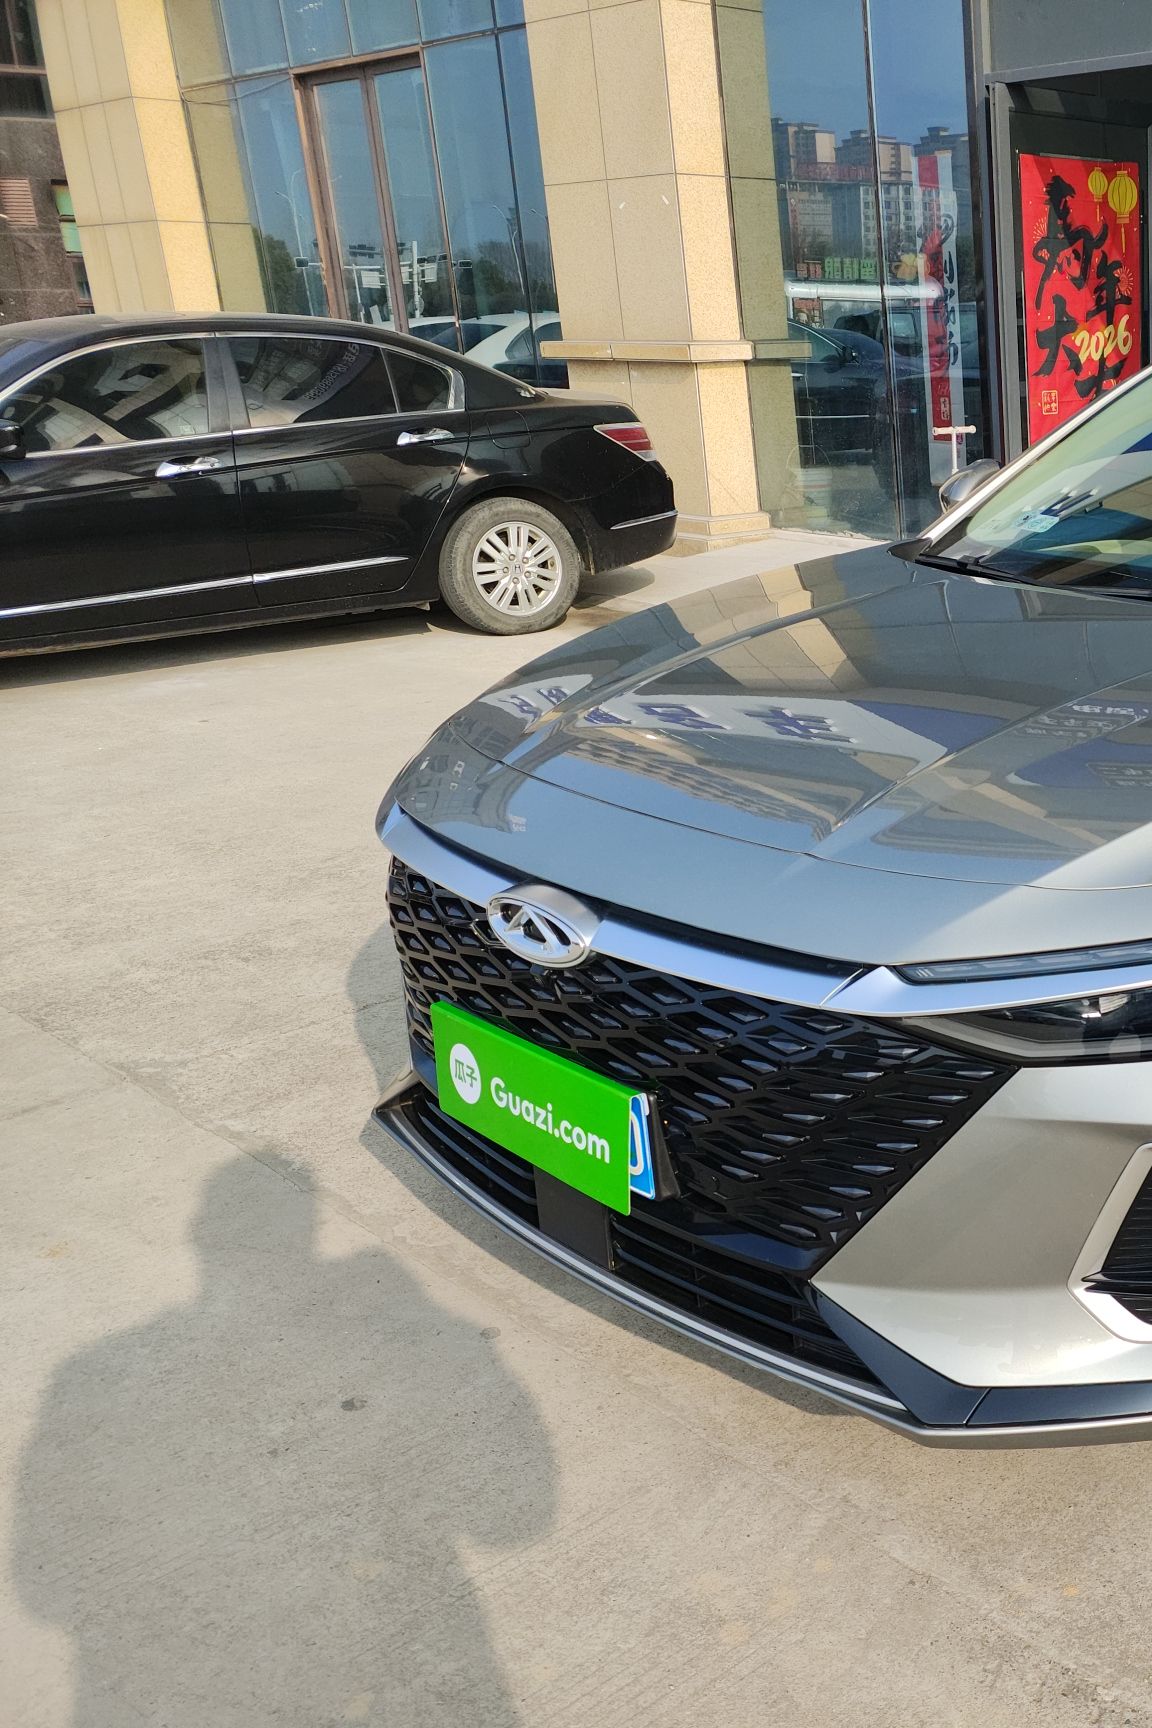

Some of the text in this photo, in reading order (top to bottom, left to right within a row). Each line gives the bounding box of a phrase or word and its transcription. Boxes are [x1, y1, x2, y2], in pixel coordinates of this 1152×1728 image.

[1074, 314, 1132, 365] 2026
[454, 1058, 478, 1088] 瓜子
[490, 1076, 611, 1164] Guazi.com
